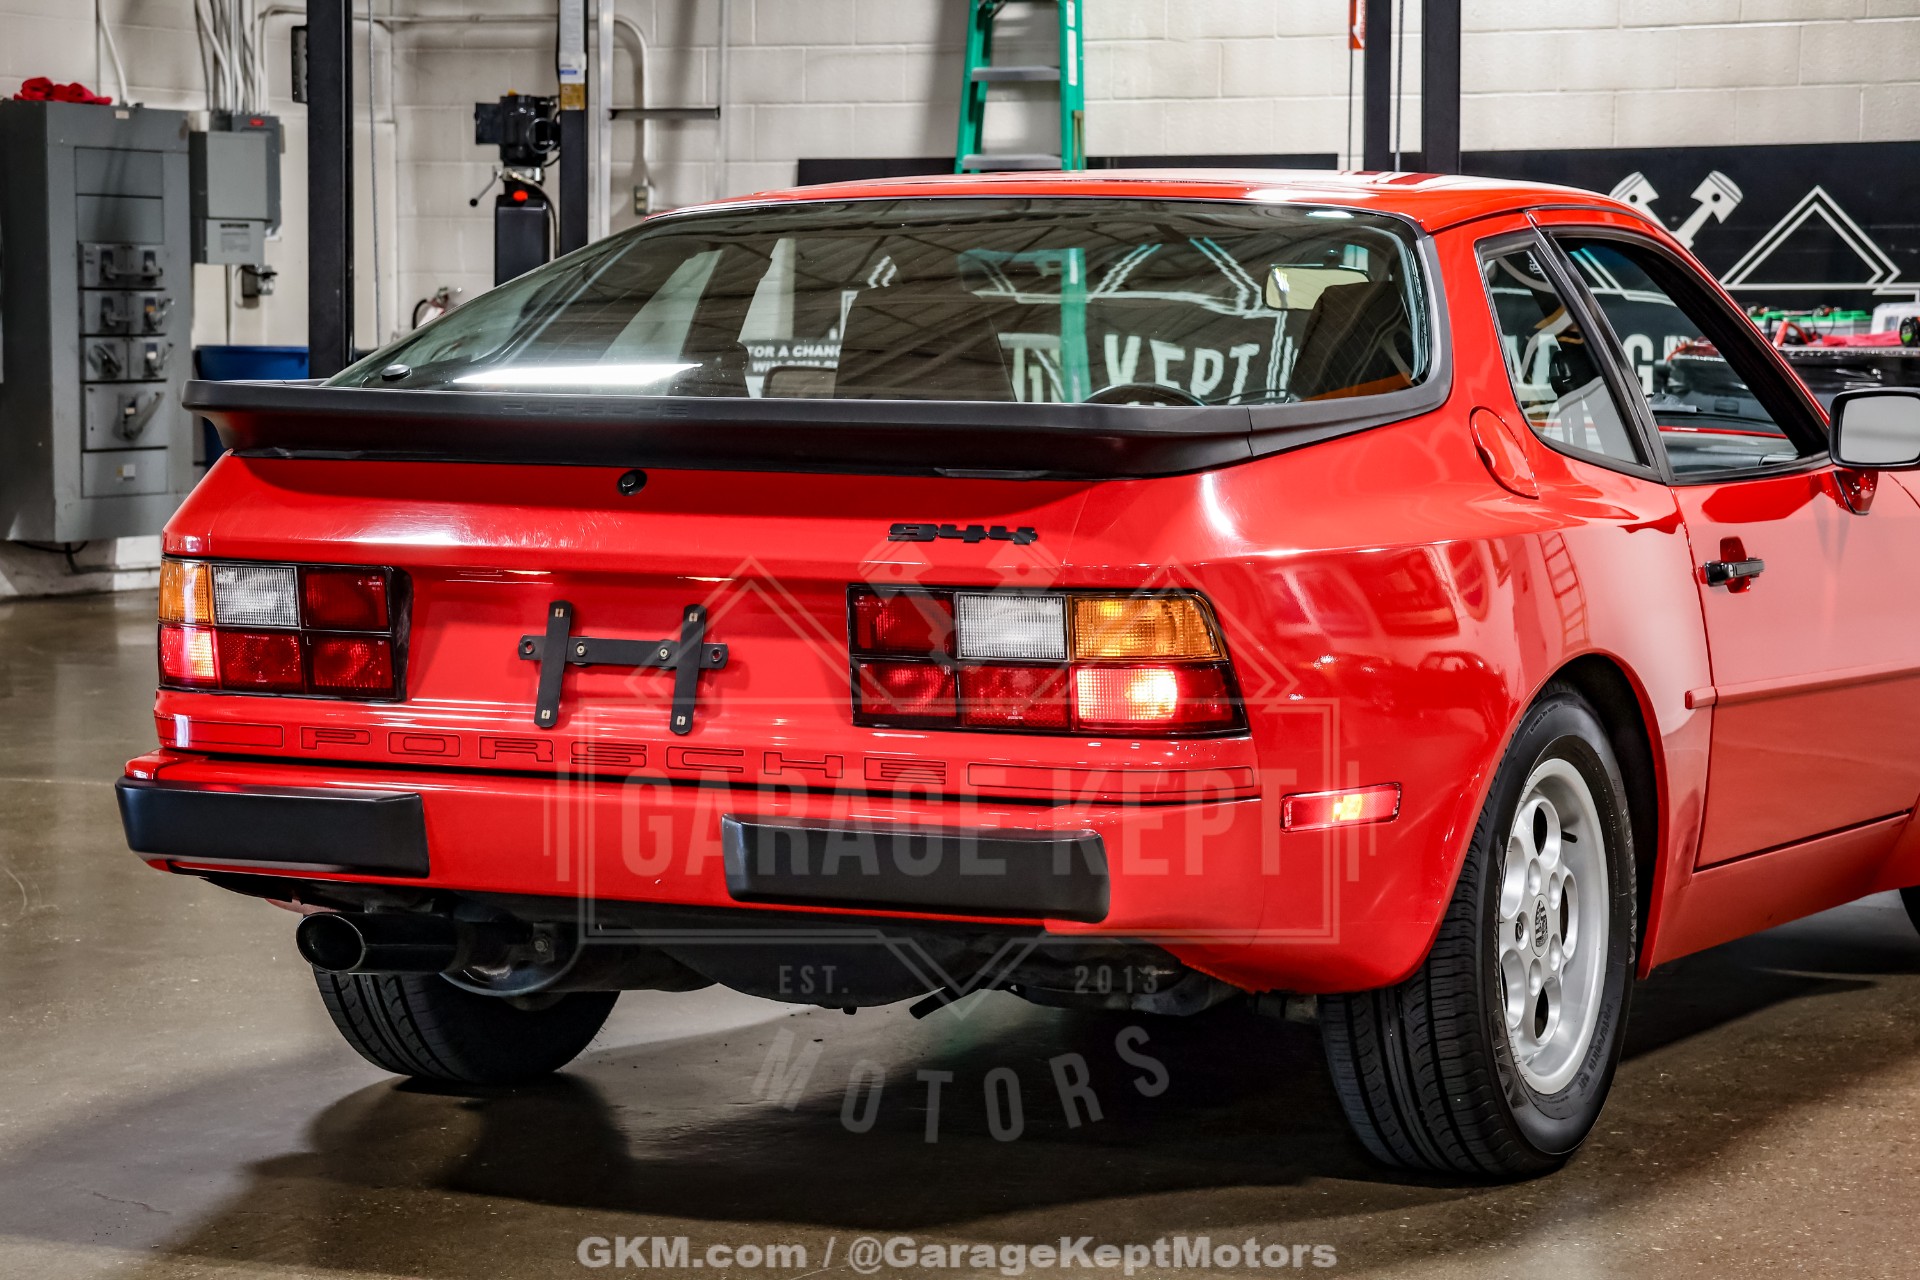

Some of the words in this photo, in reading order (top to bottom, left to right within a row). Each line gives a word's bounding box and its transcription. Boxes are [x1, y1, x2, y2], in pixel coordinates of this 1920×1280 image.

[778, 344, 790, 358] A
[887, 523, 1038, 545] 944
[300, 725, 947, 786] PORSCHE
